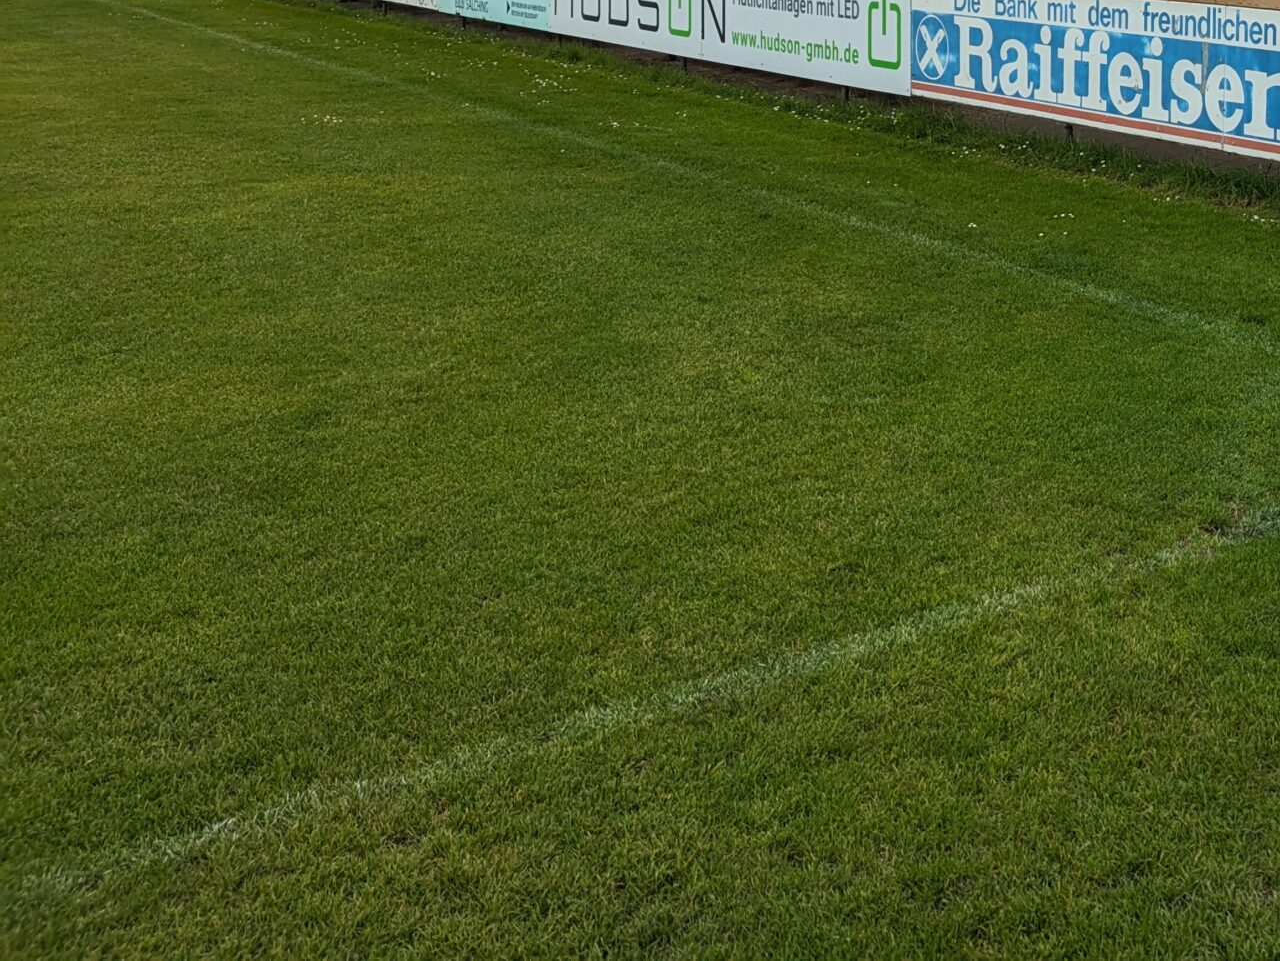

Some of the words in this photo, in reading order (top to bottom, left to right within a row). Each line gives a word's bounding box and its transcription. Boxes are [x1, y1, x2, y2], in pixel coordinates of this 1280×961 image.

[1087, 0, 1129, 29] dem
[1142, 2, 1278, 47] freundlichen
[731, 31, 860, 65] www.hudson-gmbh.de
